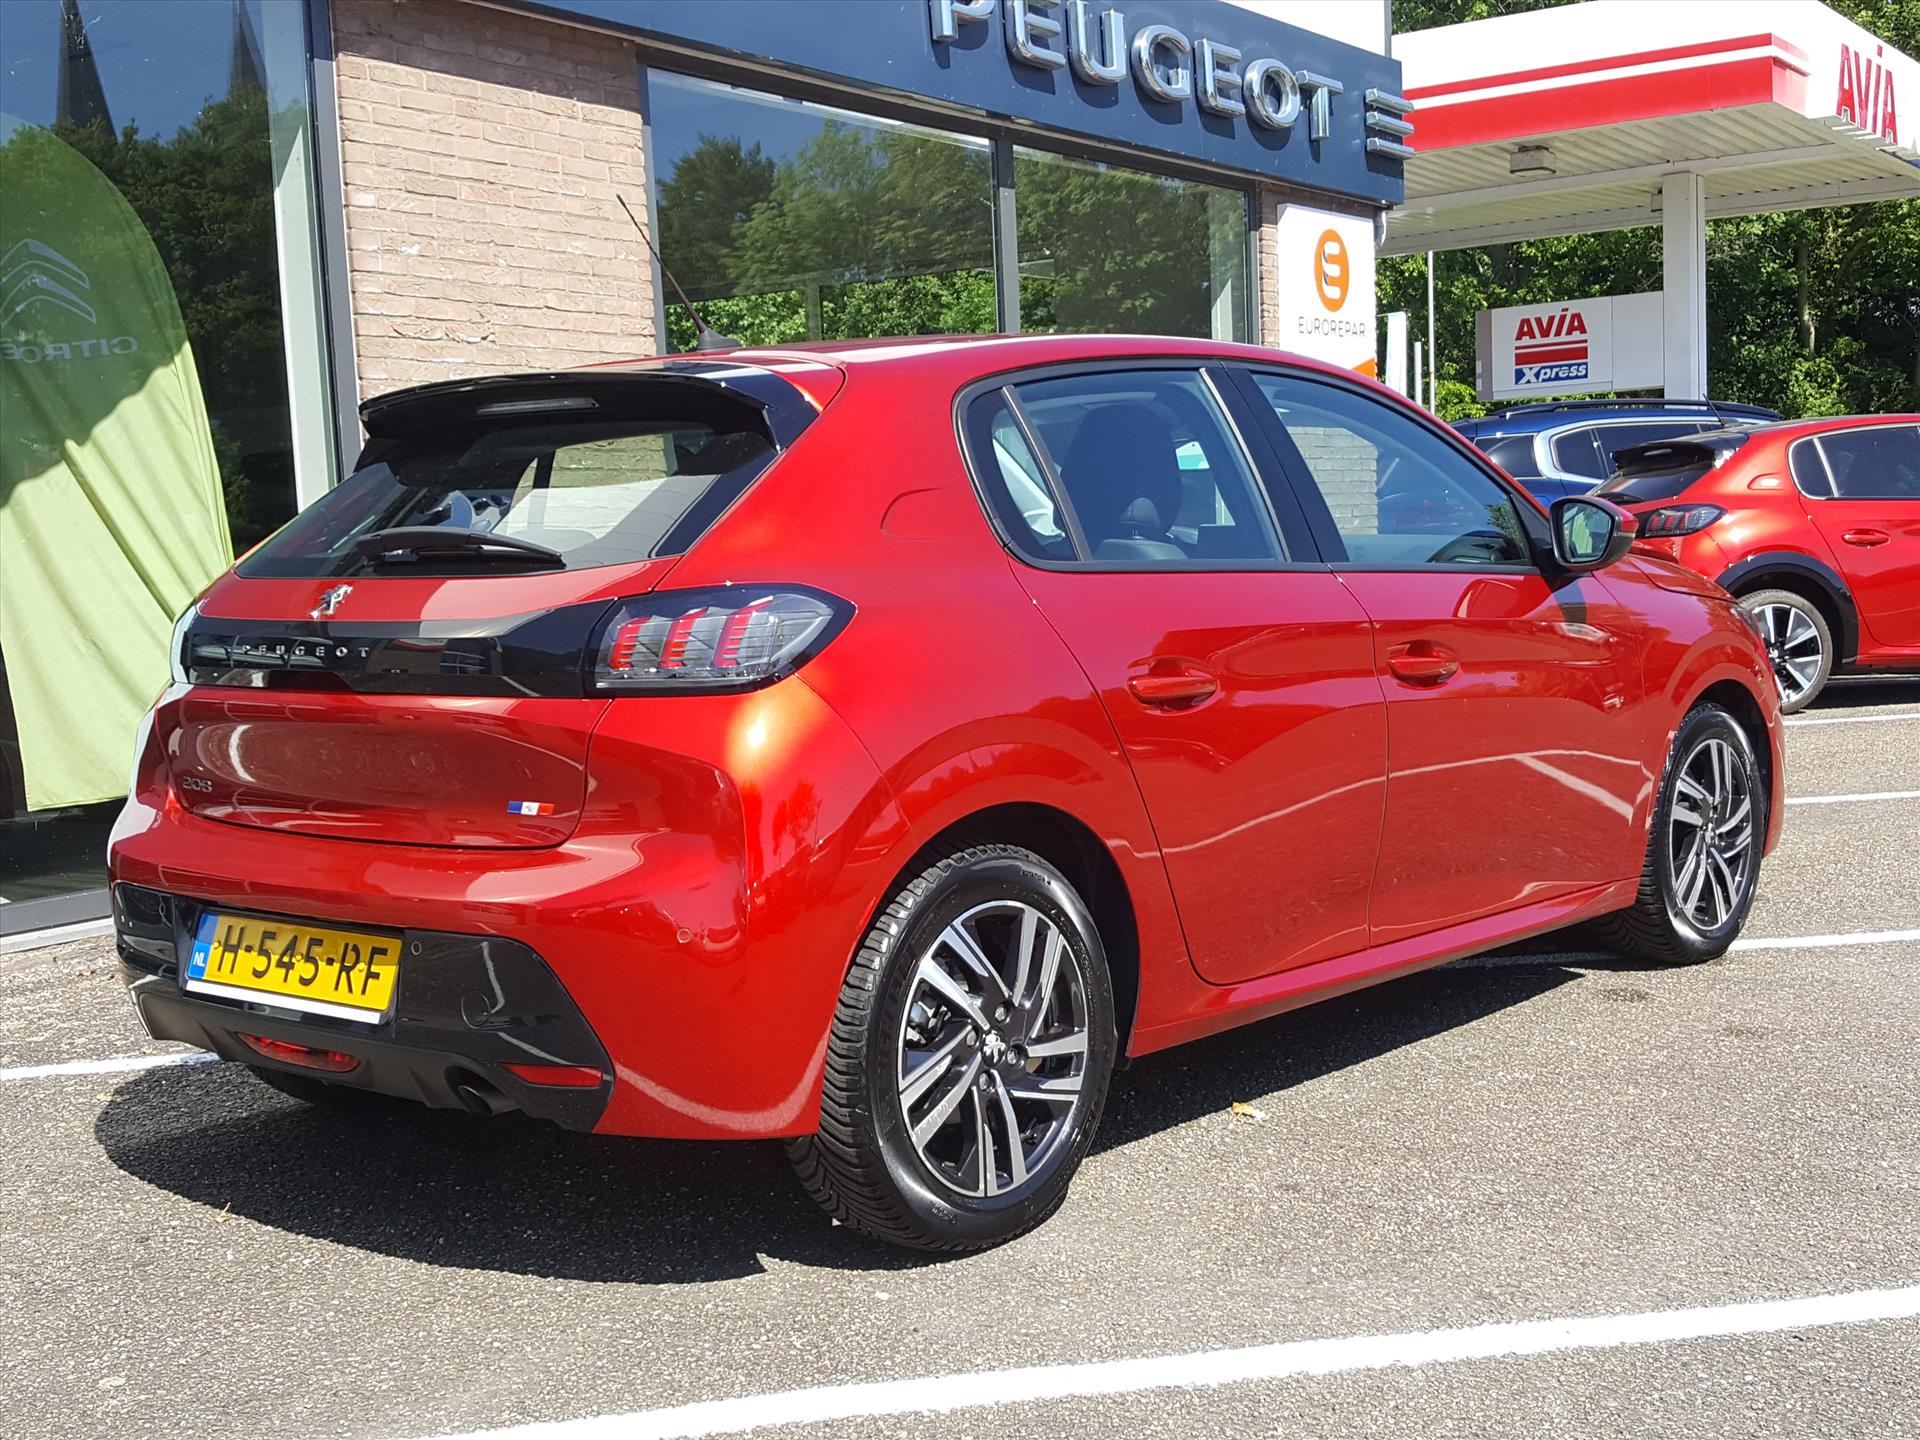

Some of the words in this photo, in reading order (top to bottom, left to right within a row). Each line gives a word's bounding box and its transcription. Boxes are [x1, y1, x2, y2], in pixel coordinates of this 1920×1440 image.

[1298, 316, 1366, 337] EUROREPAR
[1517, 364, 1587, 385] Xpress
[242, 644, 370, 657] PEUGEOT
[193, 952, 206, 967] NL
[217, 925, 388, 995] H-545-RF
